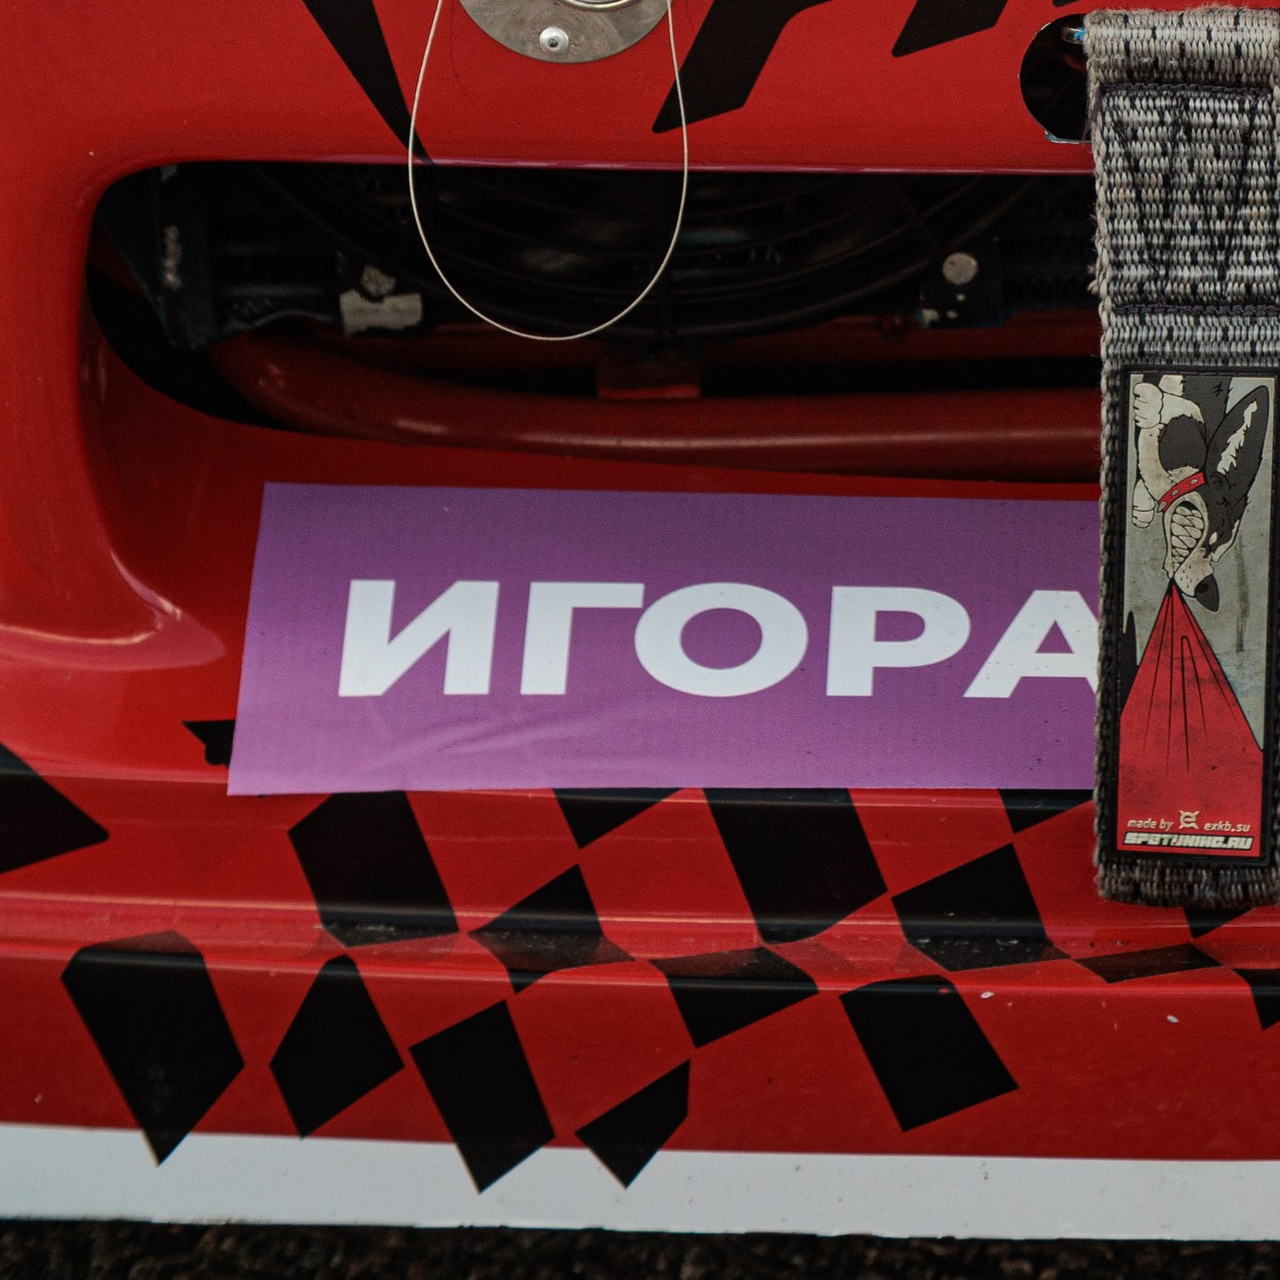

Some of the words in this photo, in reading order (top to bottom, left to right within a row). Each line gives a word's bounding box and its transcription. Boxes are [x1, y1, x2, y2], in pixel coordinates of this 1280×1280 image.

[338, 579, 1099, 698] ИГОРА
[1127, 818, 1157, 830] made
[1158, 819, 1174, 832] by
[1203, 820, 1251, 833] exkb.su
